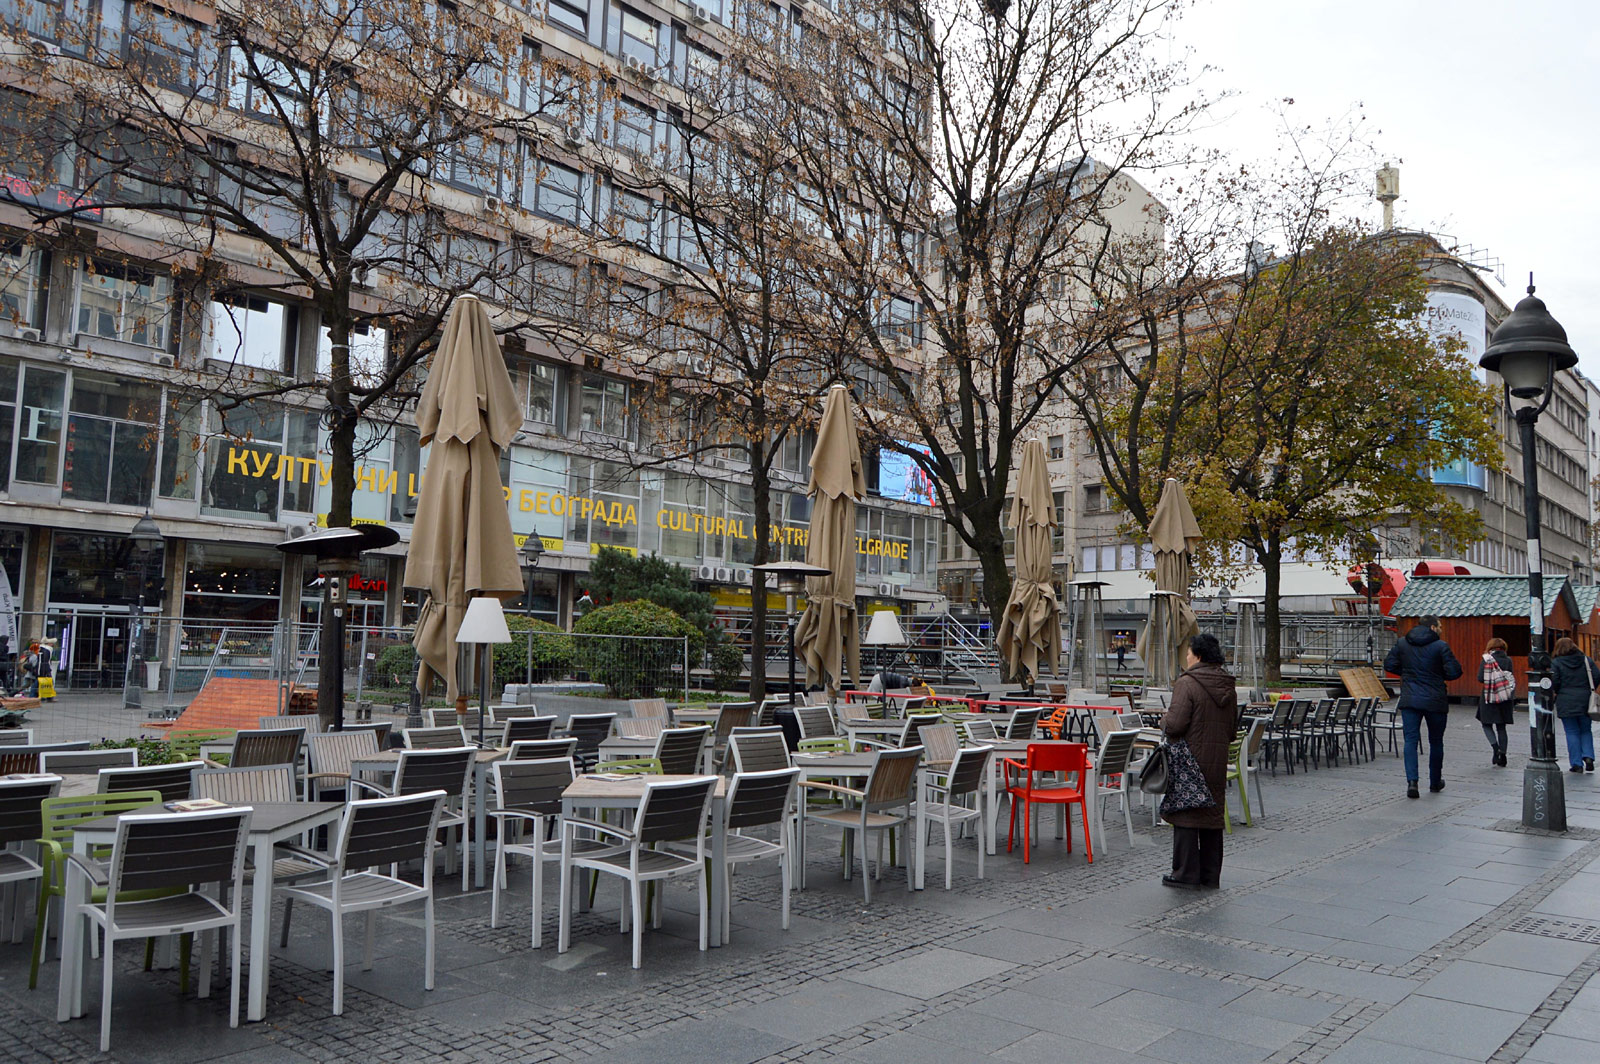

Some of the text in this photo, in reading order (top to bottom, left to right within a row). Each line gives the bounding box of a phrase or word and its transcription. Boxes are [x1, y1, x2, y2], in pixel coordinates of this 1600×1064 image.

[227, 447, 398, 495] КУЛТУНИ
[519, 489, 638, 529] БЕОГРАДА
[656, 509, 748, 540] CULTURAL
[855, 536, 909, 560] LGRADE
